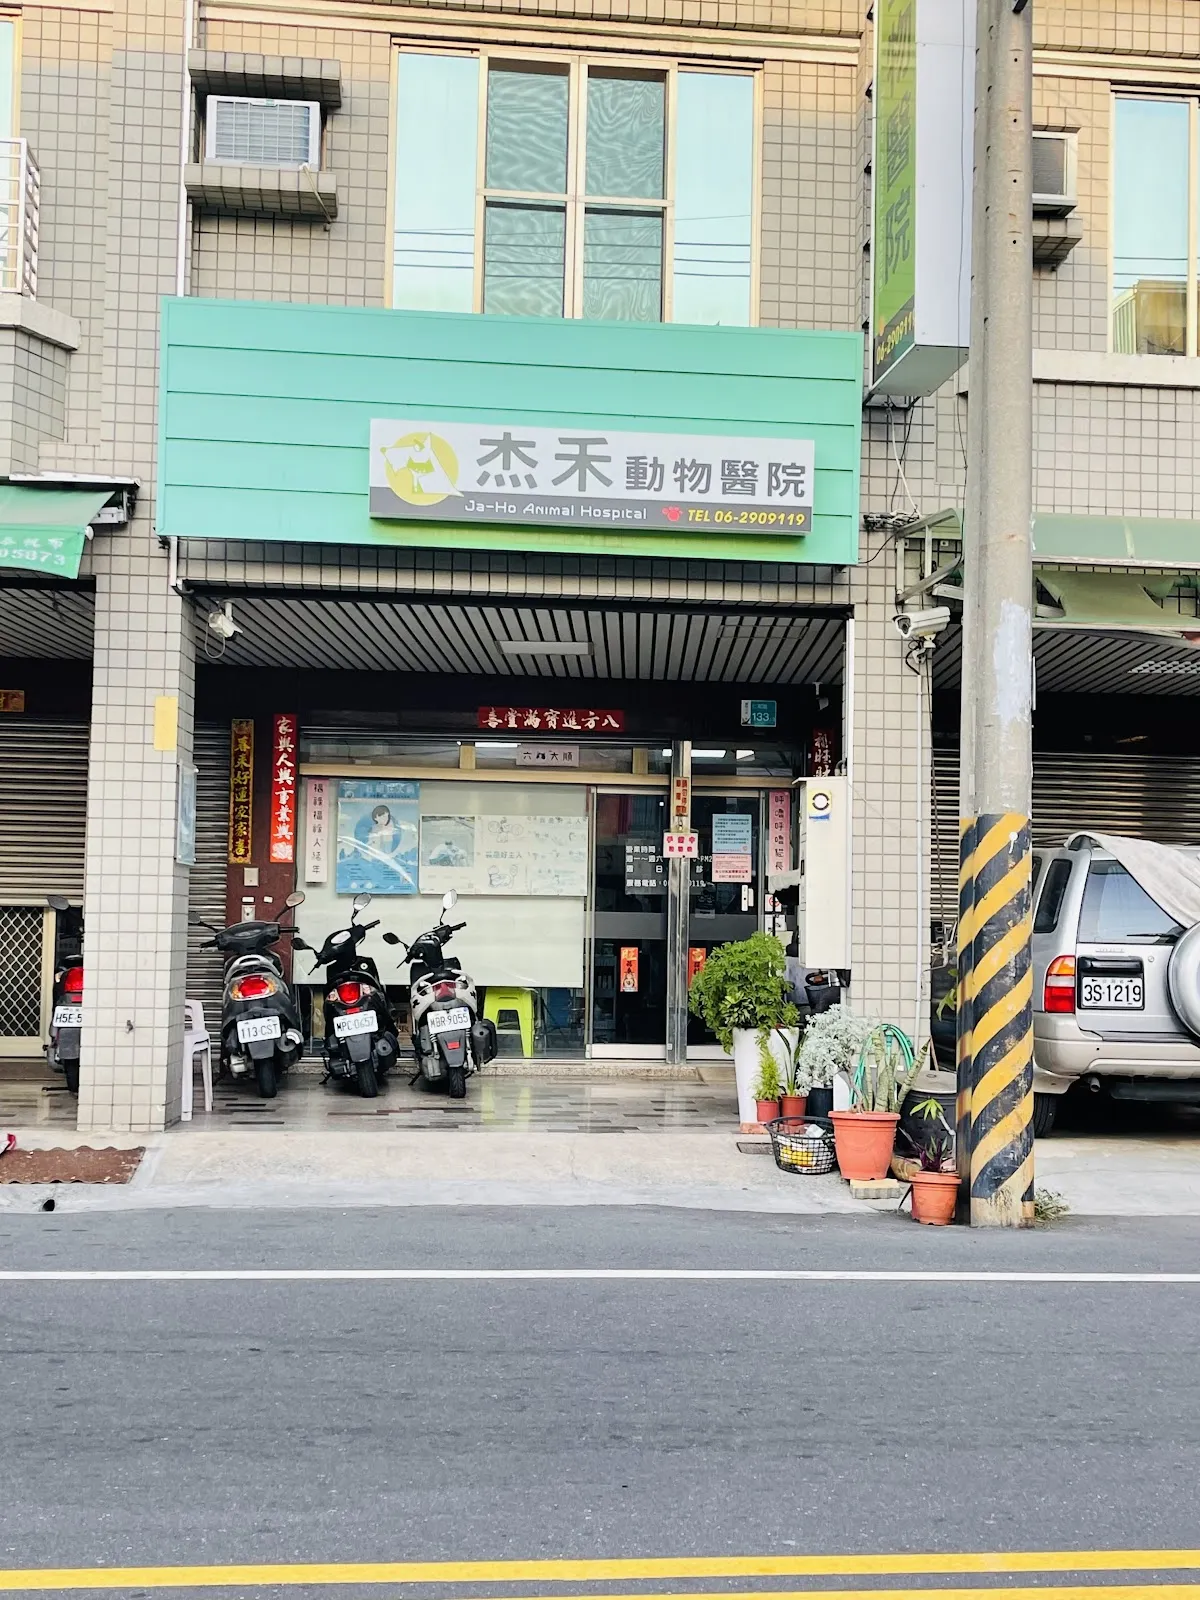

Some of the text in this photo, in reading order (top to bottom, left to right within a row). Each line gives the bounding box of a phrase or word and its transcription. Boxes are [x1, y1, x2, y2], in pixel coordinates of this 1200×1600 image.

[876, 311, 915, 365] 06-290911
[476, 431, 806, 498] 杰禾動物醫院
[464, 500, 647, 521] Ja-Ho Animal Hospital
[687, 509, 805, 526] TEL 06-2909119
[751, 712, 769, 722] 133
